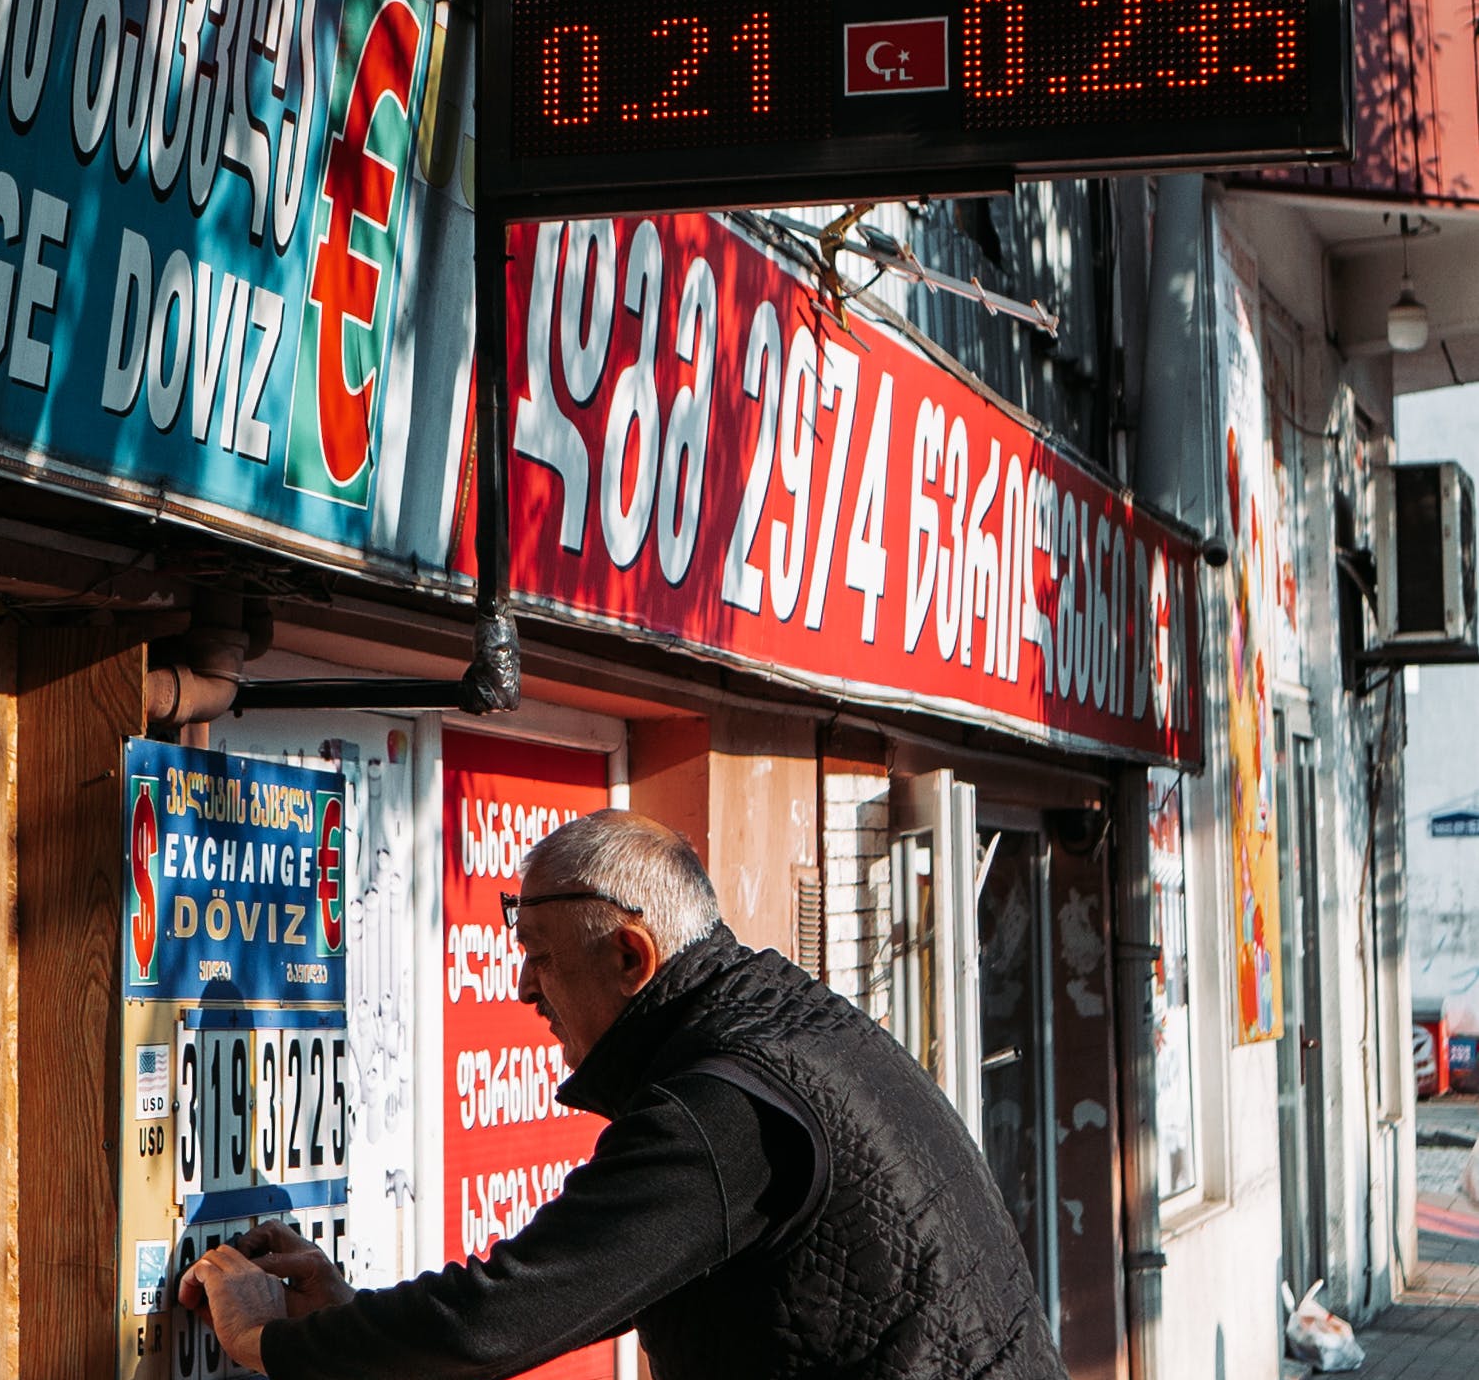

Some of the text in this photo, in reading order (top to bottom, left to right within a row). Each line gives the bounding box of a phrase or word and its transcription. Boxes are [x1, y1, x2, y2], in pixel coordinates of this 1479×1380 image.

[541, 8, 772, 129] 0.21
[879, 66, 914, 83] TL
[102, 226, 286, 464] DOVIZ
[720, 300, 893, 643] 2974
[167, 767, 314, 834] ვალუტის გაცვლა
[164, 833, 313, 888] EXCHANGE
[174, 889, 307, 946] DÖVIZ
[142, 1098, 164, 1112] USD
[139, 1126, 164, 1157] USD
[141, 1291, 162, 1307] EUR
[138, 1324, 162, 1356] ER
